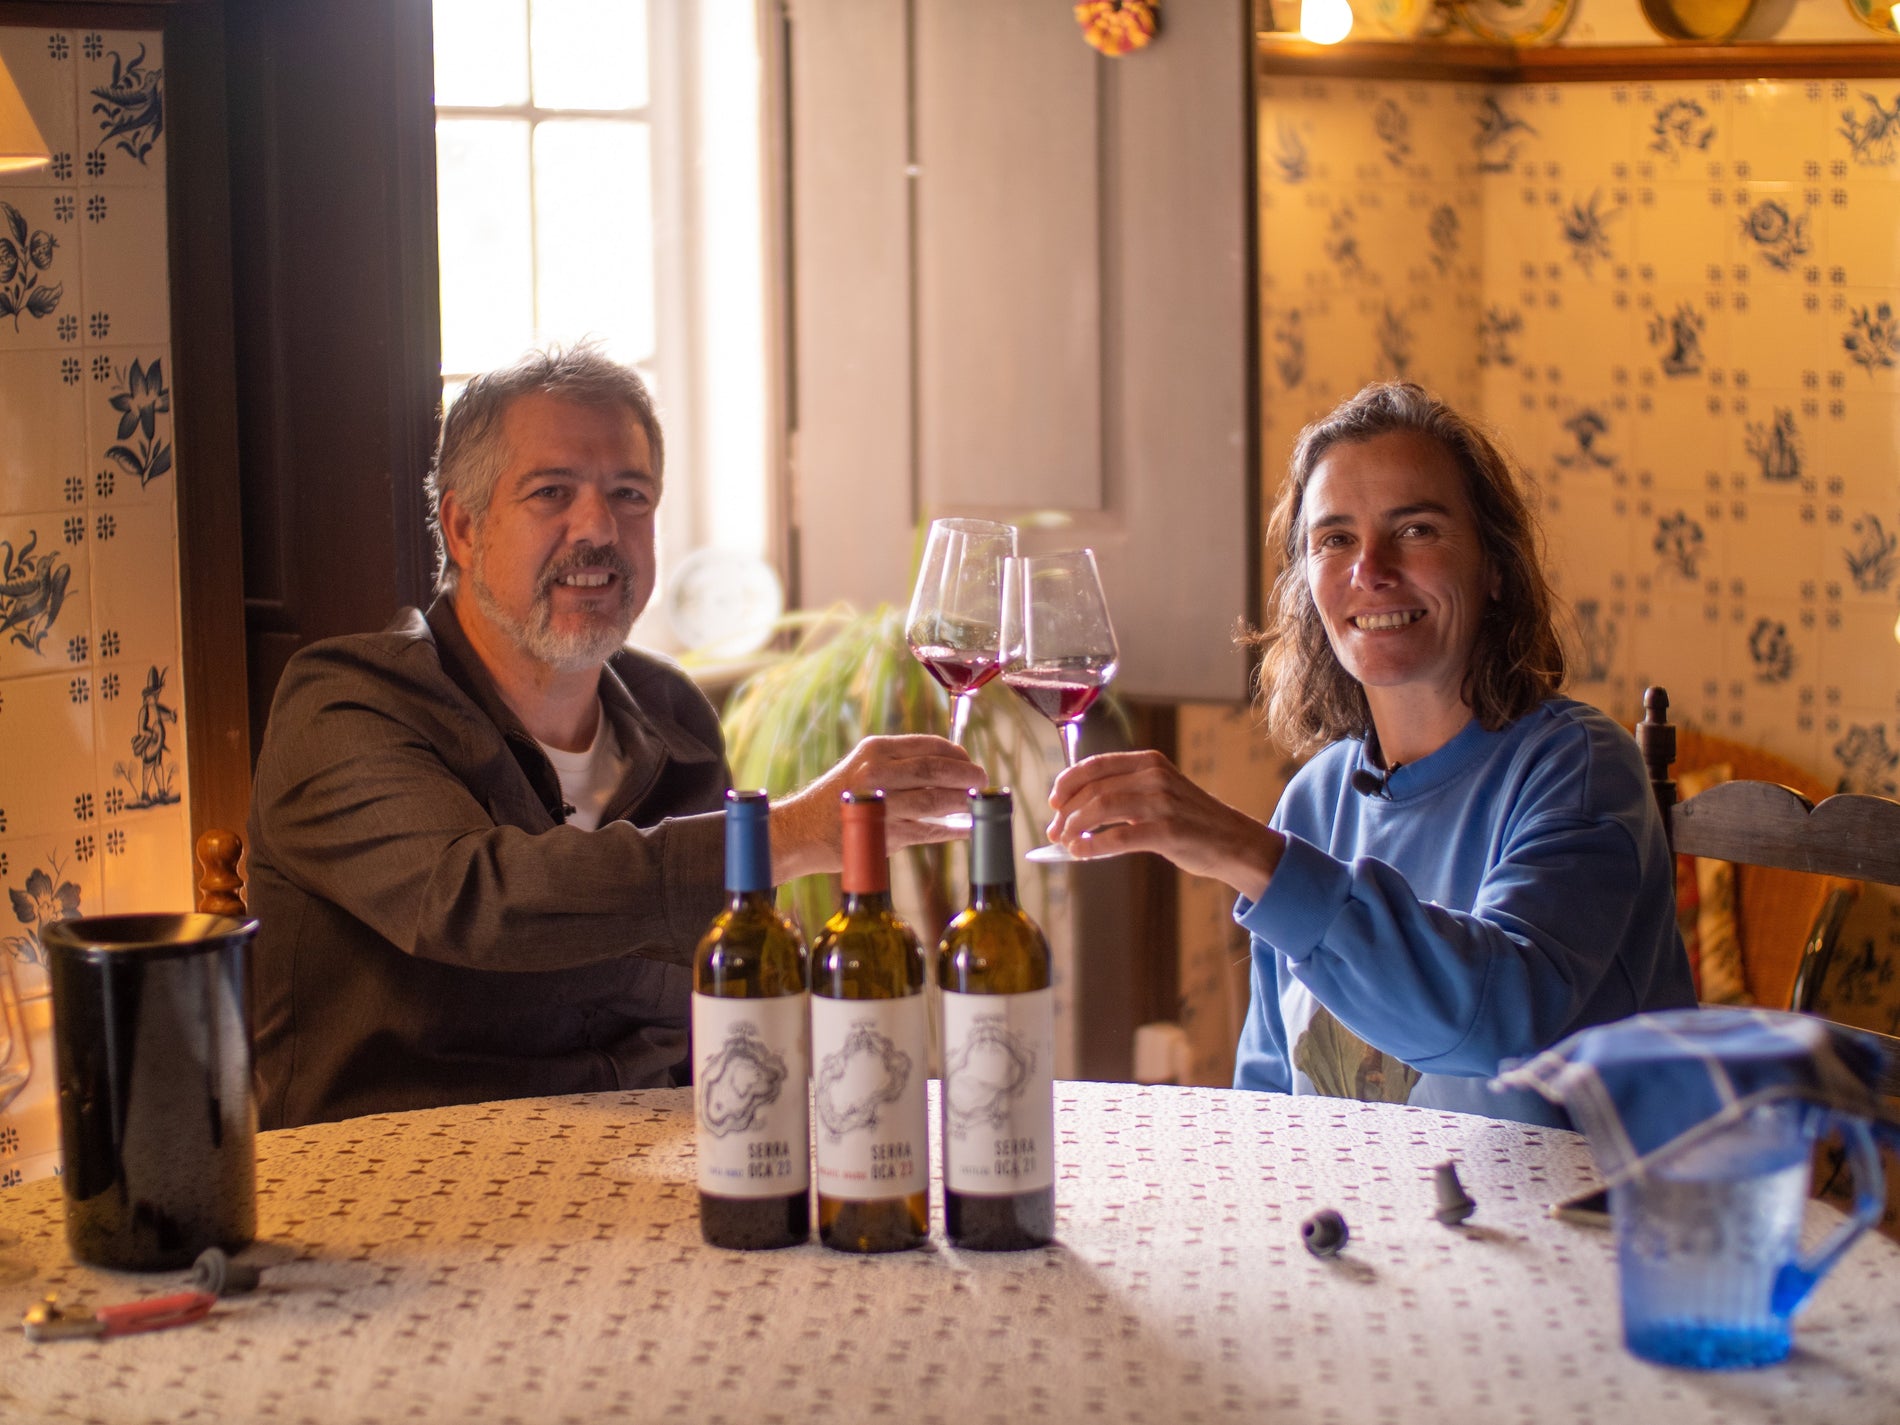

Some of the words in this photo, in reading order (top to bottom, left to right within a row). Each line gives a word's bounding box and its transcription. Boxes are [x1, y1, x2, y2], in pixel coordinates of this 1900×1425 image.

[748, 1142, 790, 1158] SERRA
[871, 1143, 912, 1160] SERRA
[994, 1138, 1035, 1157] SERRA
[748, 1161, 772, 1178] OCA
[871, 1163, 896, 1180] OCA
[994, 1158, 1020, 1177] OCA
